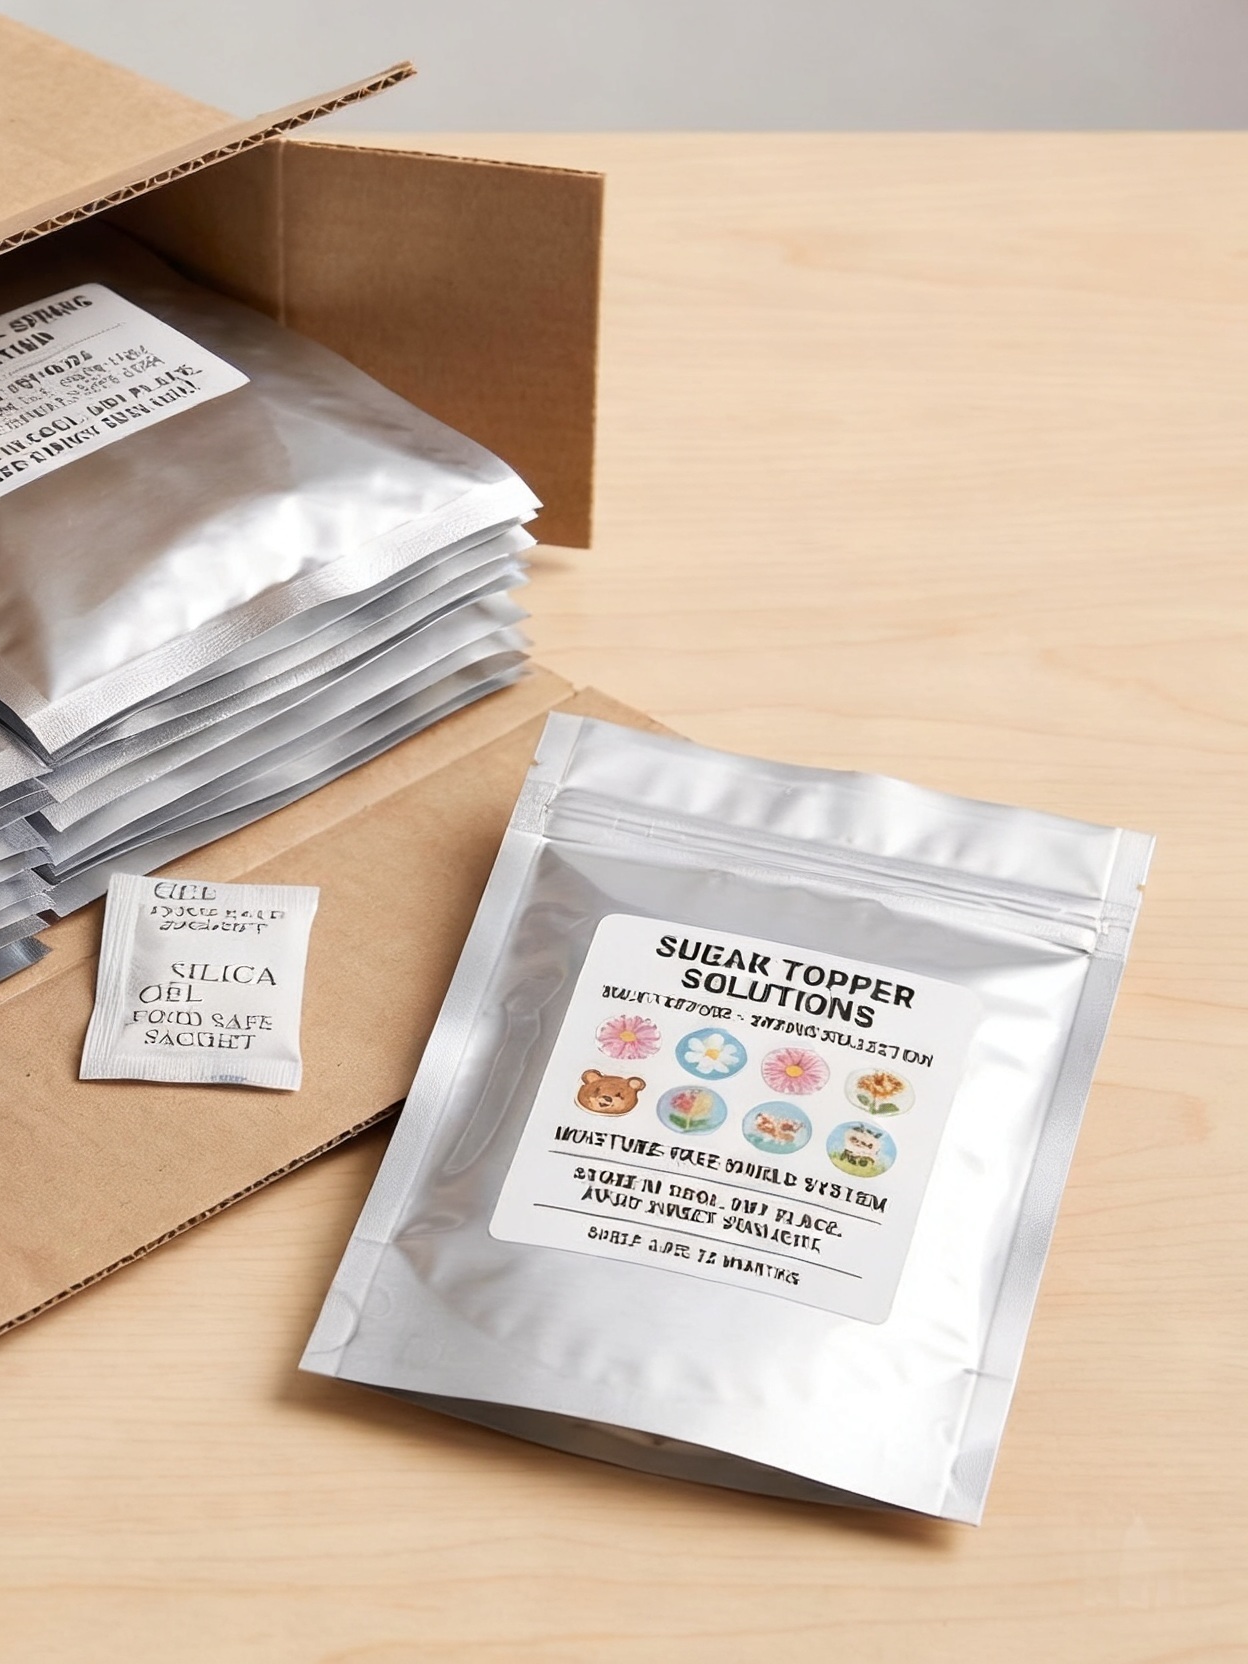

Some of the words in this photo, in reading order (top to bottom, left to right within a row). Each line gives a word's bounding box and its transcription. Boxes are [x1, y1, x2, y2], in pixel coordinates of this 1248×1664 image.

[681, 969, 874, 1028] SOLUTIONS
[783, 959, 914, 1008] TOPPER
[212, 1013, 272, 1030] SAFE
